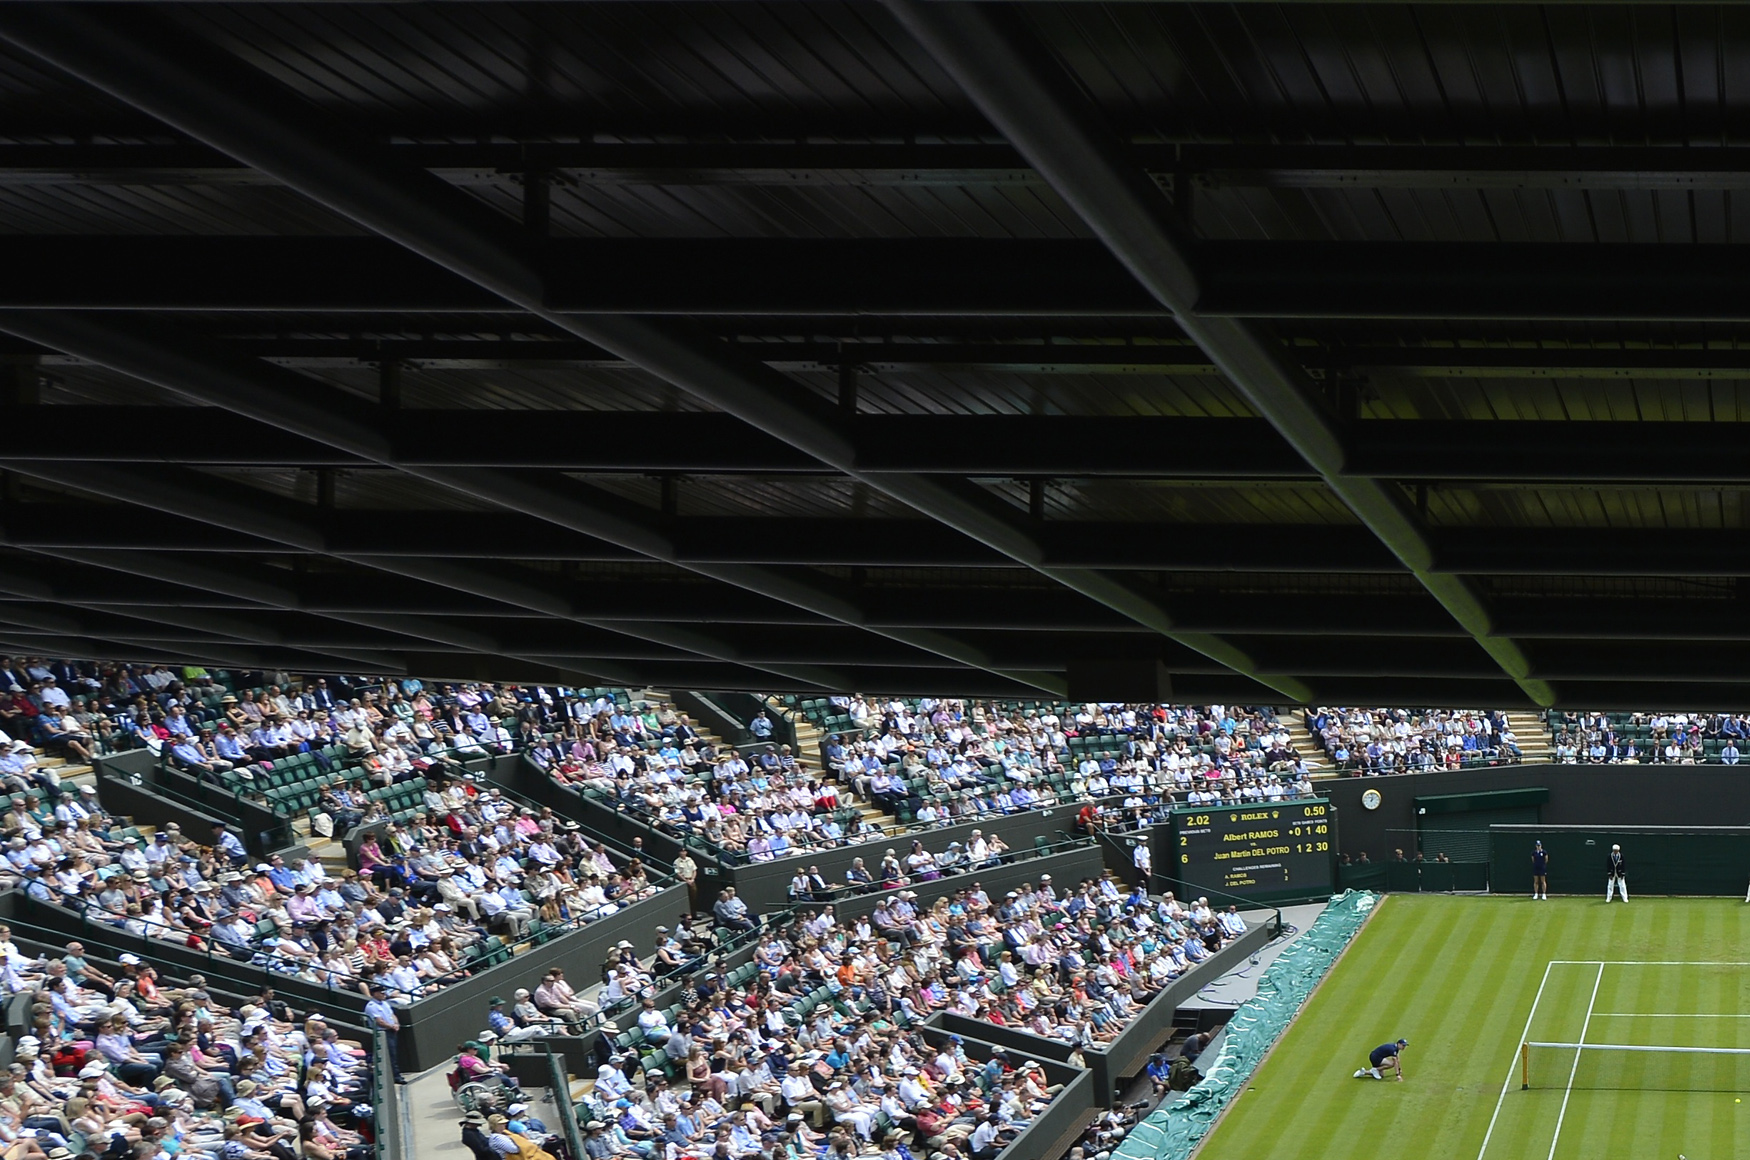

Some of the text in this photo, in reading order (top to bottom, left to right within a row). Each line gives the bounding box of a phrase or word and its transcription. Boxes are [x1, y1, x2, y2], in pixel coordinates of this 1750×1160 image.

[1241, 812, 1268, 821] ROLEX
[1303, 806, 1325, 817] 0.50
[1186, 815, 1210, 826] 2.02
[1223, 830, 1279, 842] Albert RAMOS
[1294, 825, 1328, 836] 0 1 40
[1180, 836, 1188, 846] 2
[1214, 852, 1230, 860] Juan
[1252, 848, 1266, 857] DEL
[1266, 846, 1290, 856] POTRO
[1296, 842, 1329, 853] 1 2 30
[1181, 854, 1188, 864] 6
